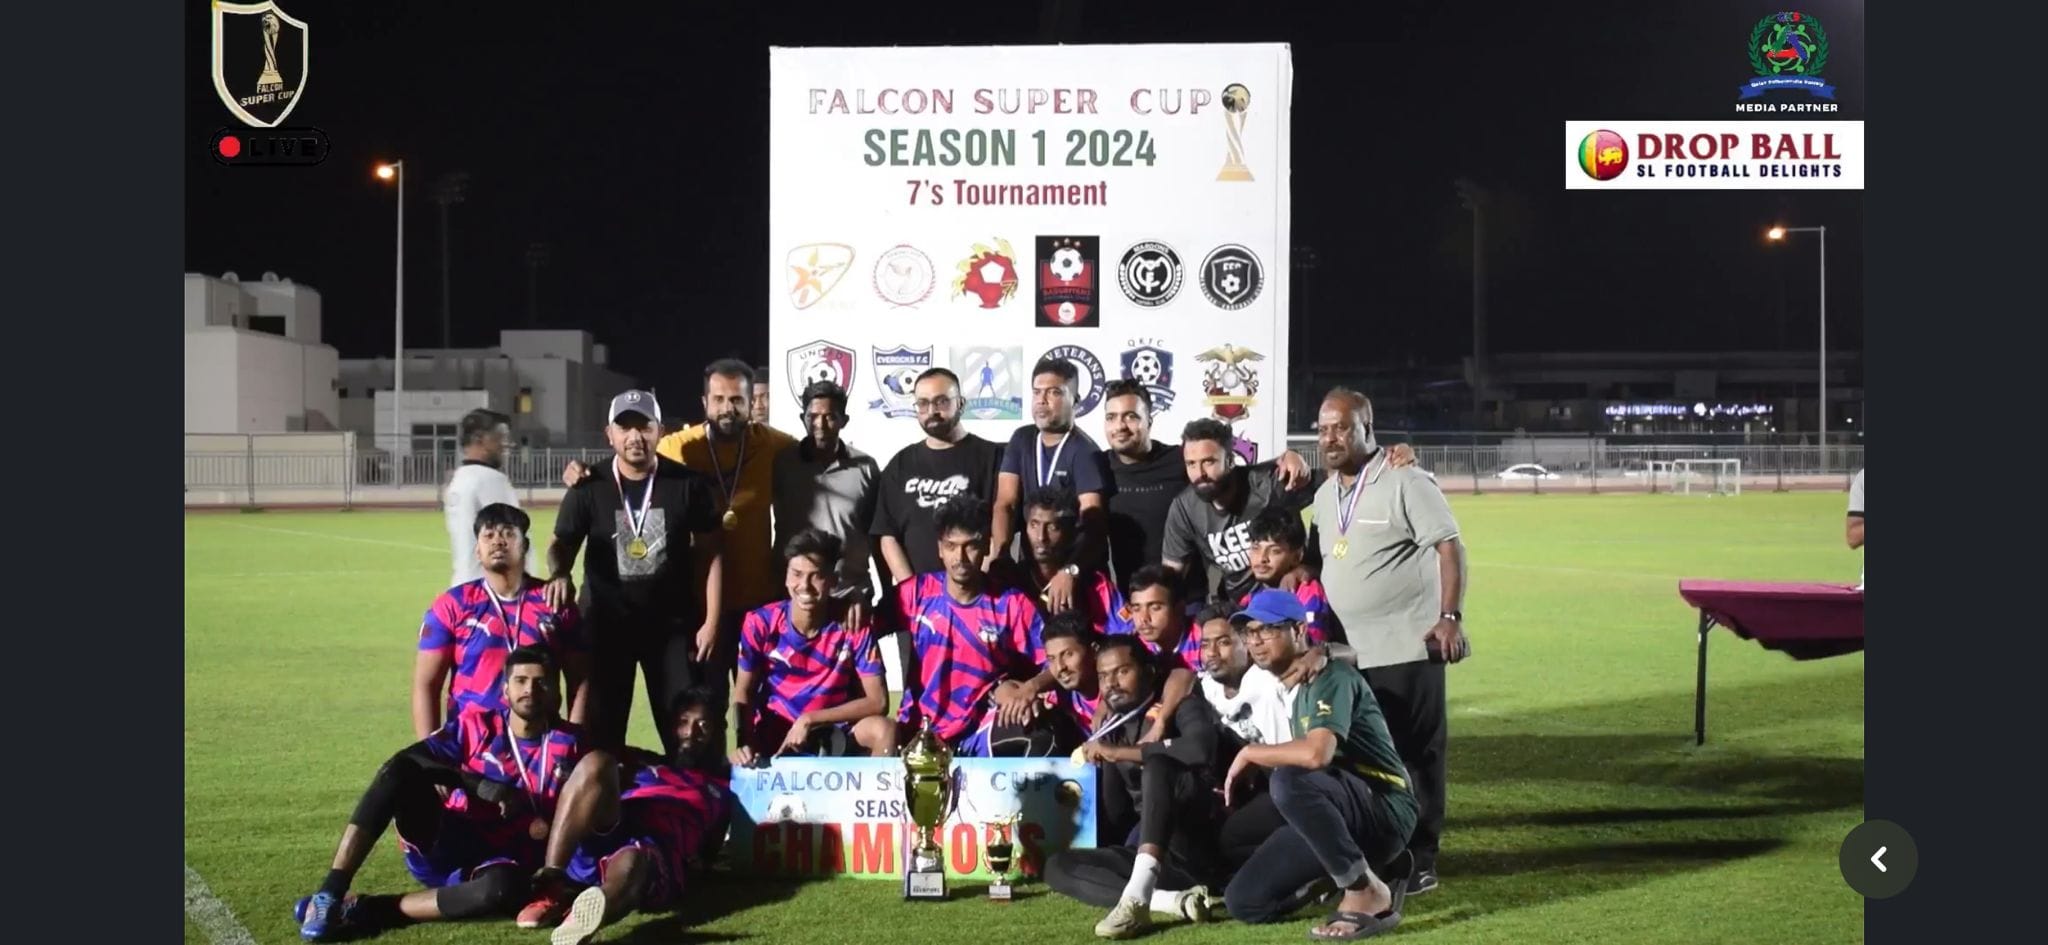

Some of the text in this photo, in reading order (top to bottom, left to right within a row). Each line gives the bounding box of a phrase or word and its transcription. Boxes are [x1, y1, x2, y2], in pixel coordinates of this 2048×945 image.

[808, 86, 1212, 115] FALCON SUPER CUP
[864, 128, 1157, 167] SEASON 1 2024
[954, 179, 1107, 206] Tournament
[1046, 347, 1103, 401] VETERANS FC
[1207, 520, 1252, 557] KEE
[756, 771, 862, 791] FALCON
[990, 771, 1048, 792] CUP
[855, 799, 906, 818] SEAS
